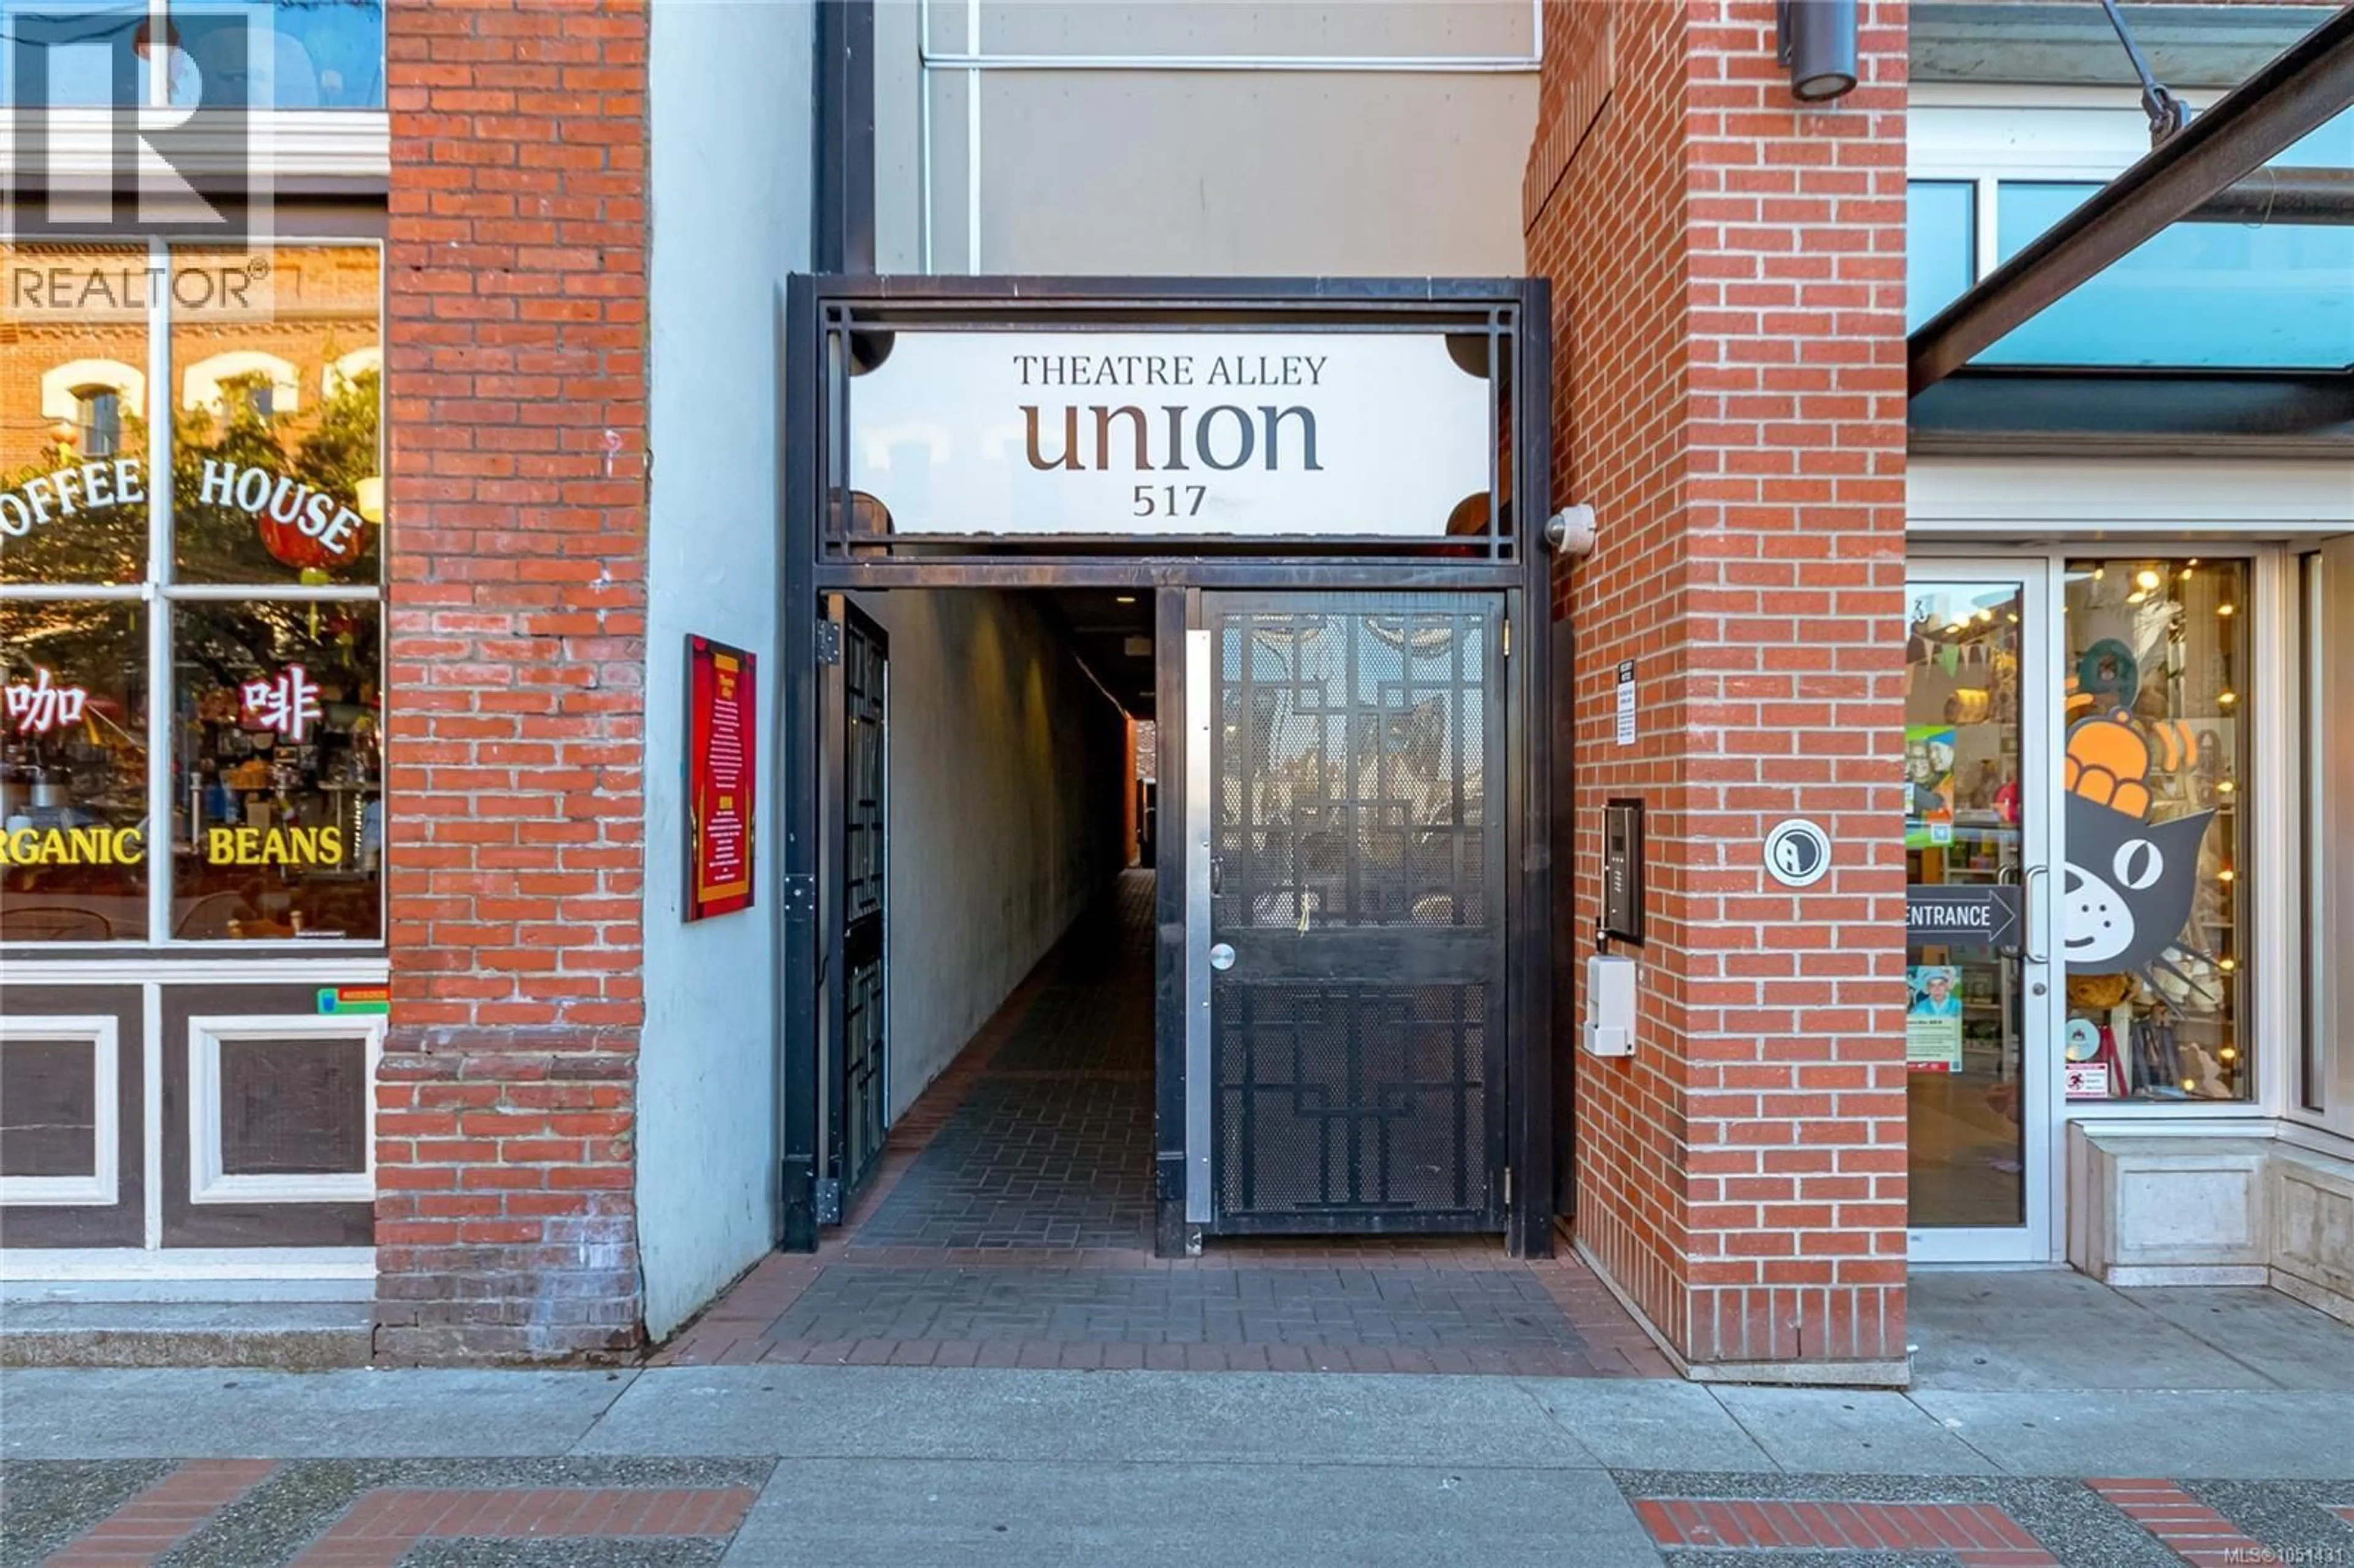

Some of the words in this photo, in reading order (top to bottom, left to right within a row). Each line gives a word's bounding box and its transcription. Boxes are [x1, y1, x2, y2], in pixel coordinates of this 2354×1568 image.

[1013, 356, 1193, 385] THEATRE
[1207, 356, 1328, 385] ALLEY
[0, 459, 145, 543] OFFEE
[199, 459, 364, 554] HOUSE
[1133, 485, 1207, 517] 517
[3, 666, 87, 733] 咖
[243, 664, 324, 742] 啡
[207, 827, 343, 864] BEANS
